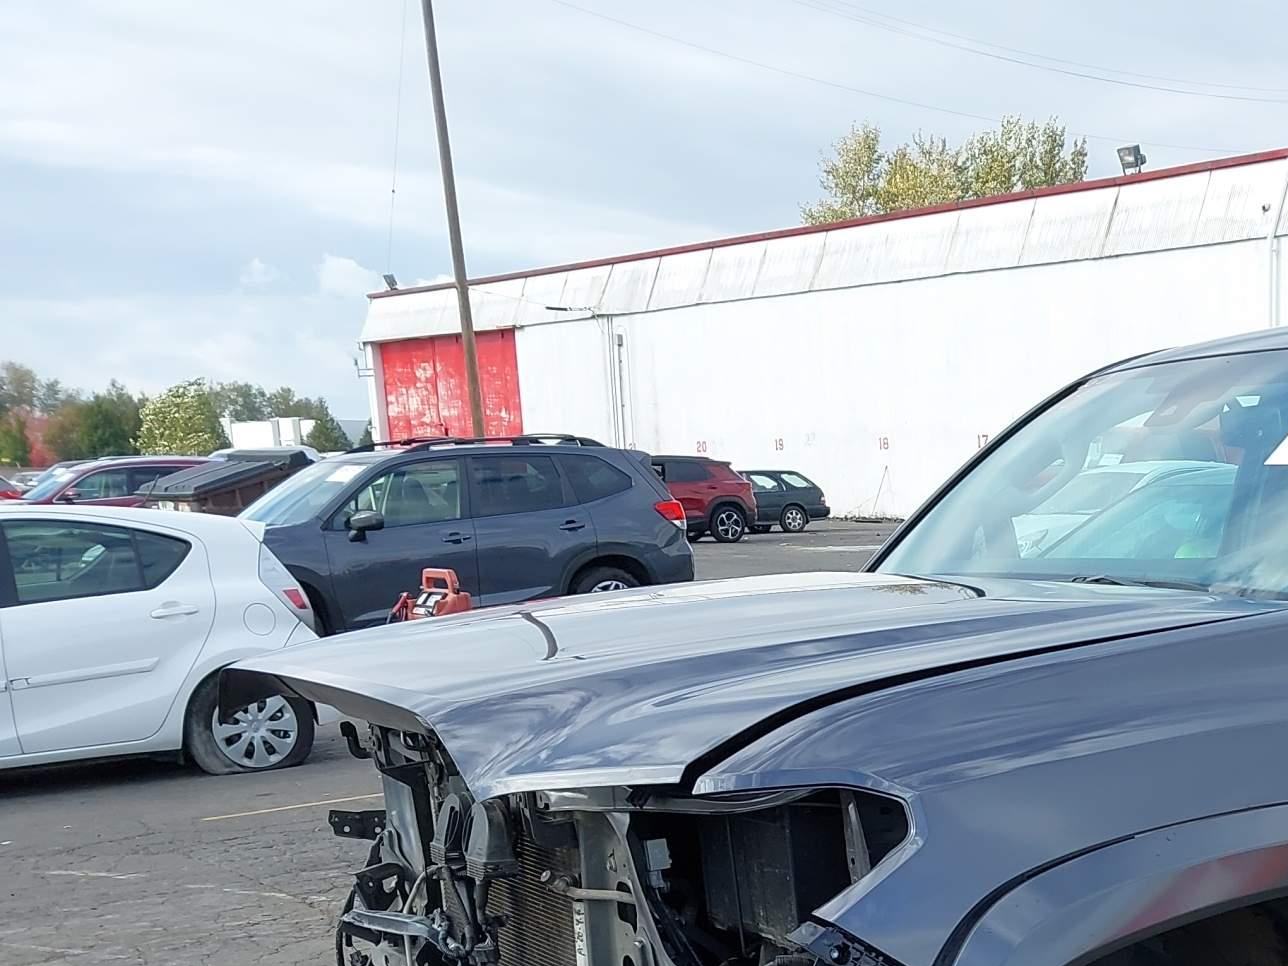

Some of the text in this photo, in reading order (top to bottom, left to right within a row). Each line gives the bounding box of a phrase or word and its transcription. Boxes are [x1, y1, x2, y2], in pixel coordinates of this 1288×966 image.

[696, 441, 707, 453] 20
[774, 438, 784, 451] 19
[878, 437, 889, 450] 18
[977, 434, 989, 449] 17
